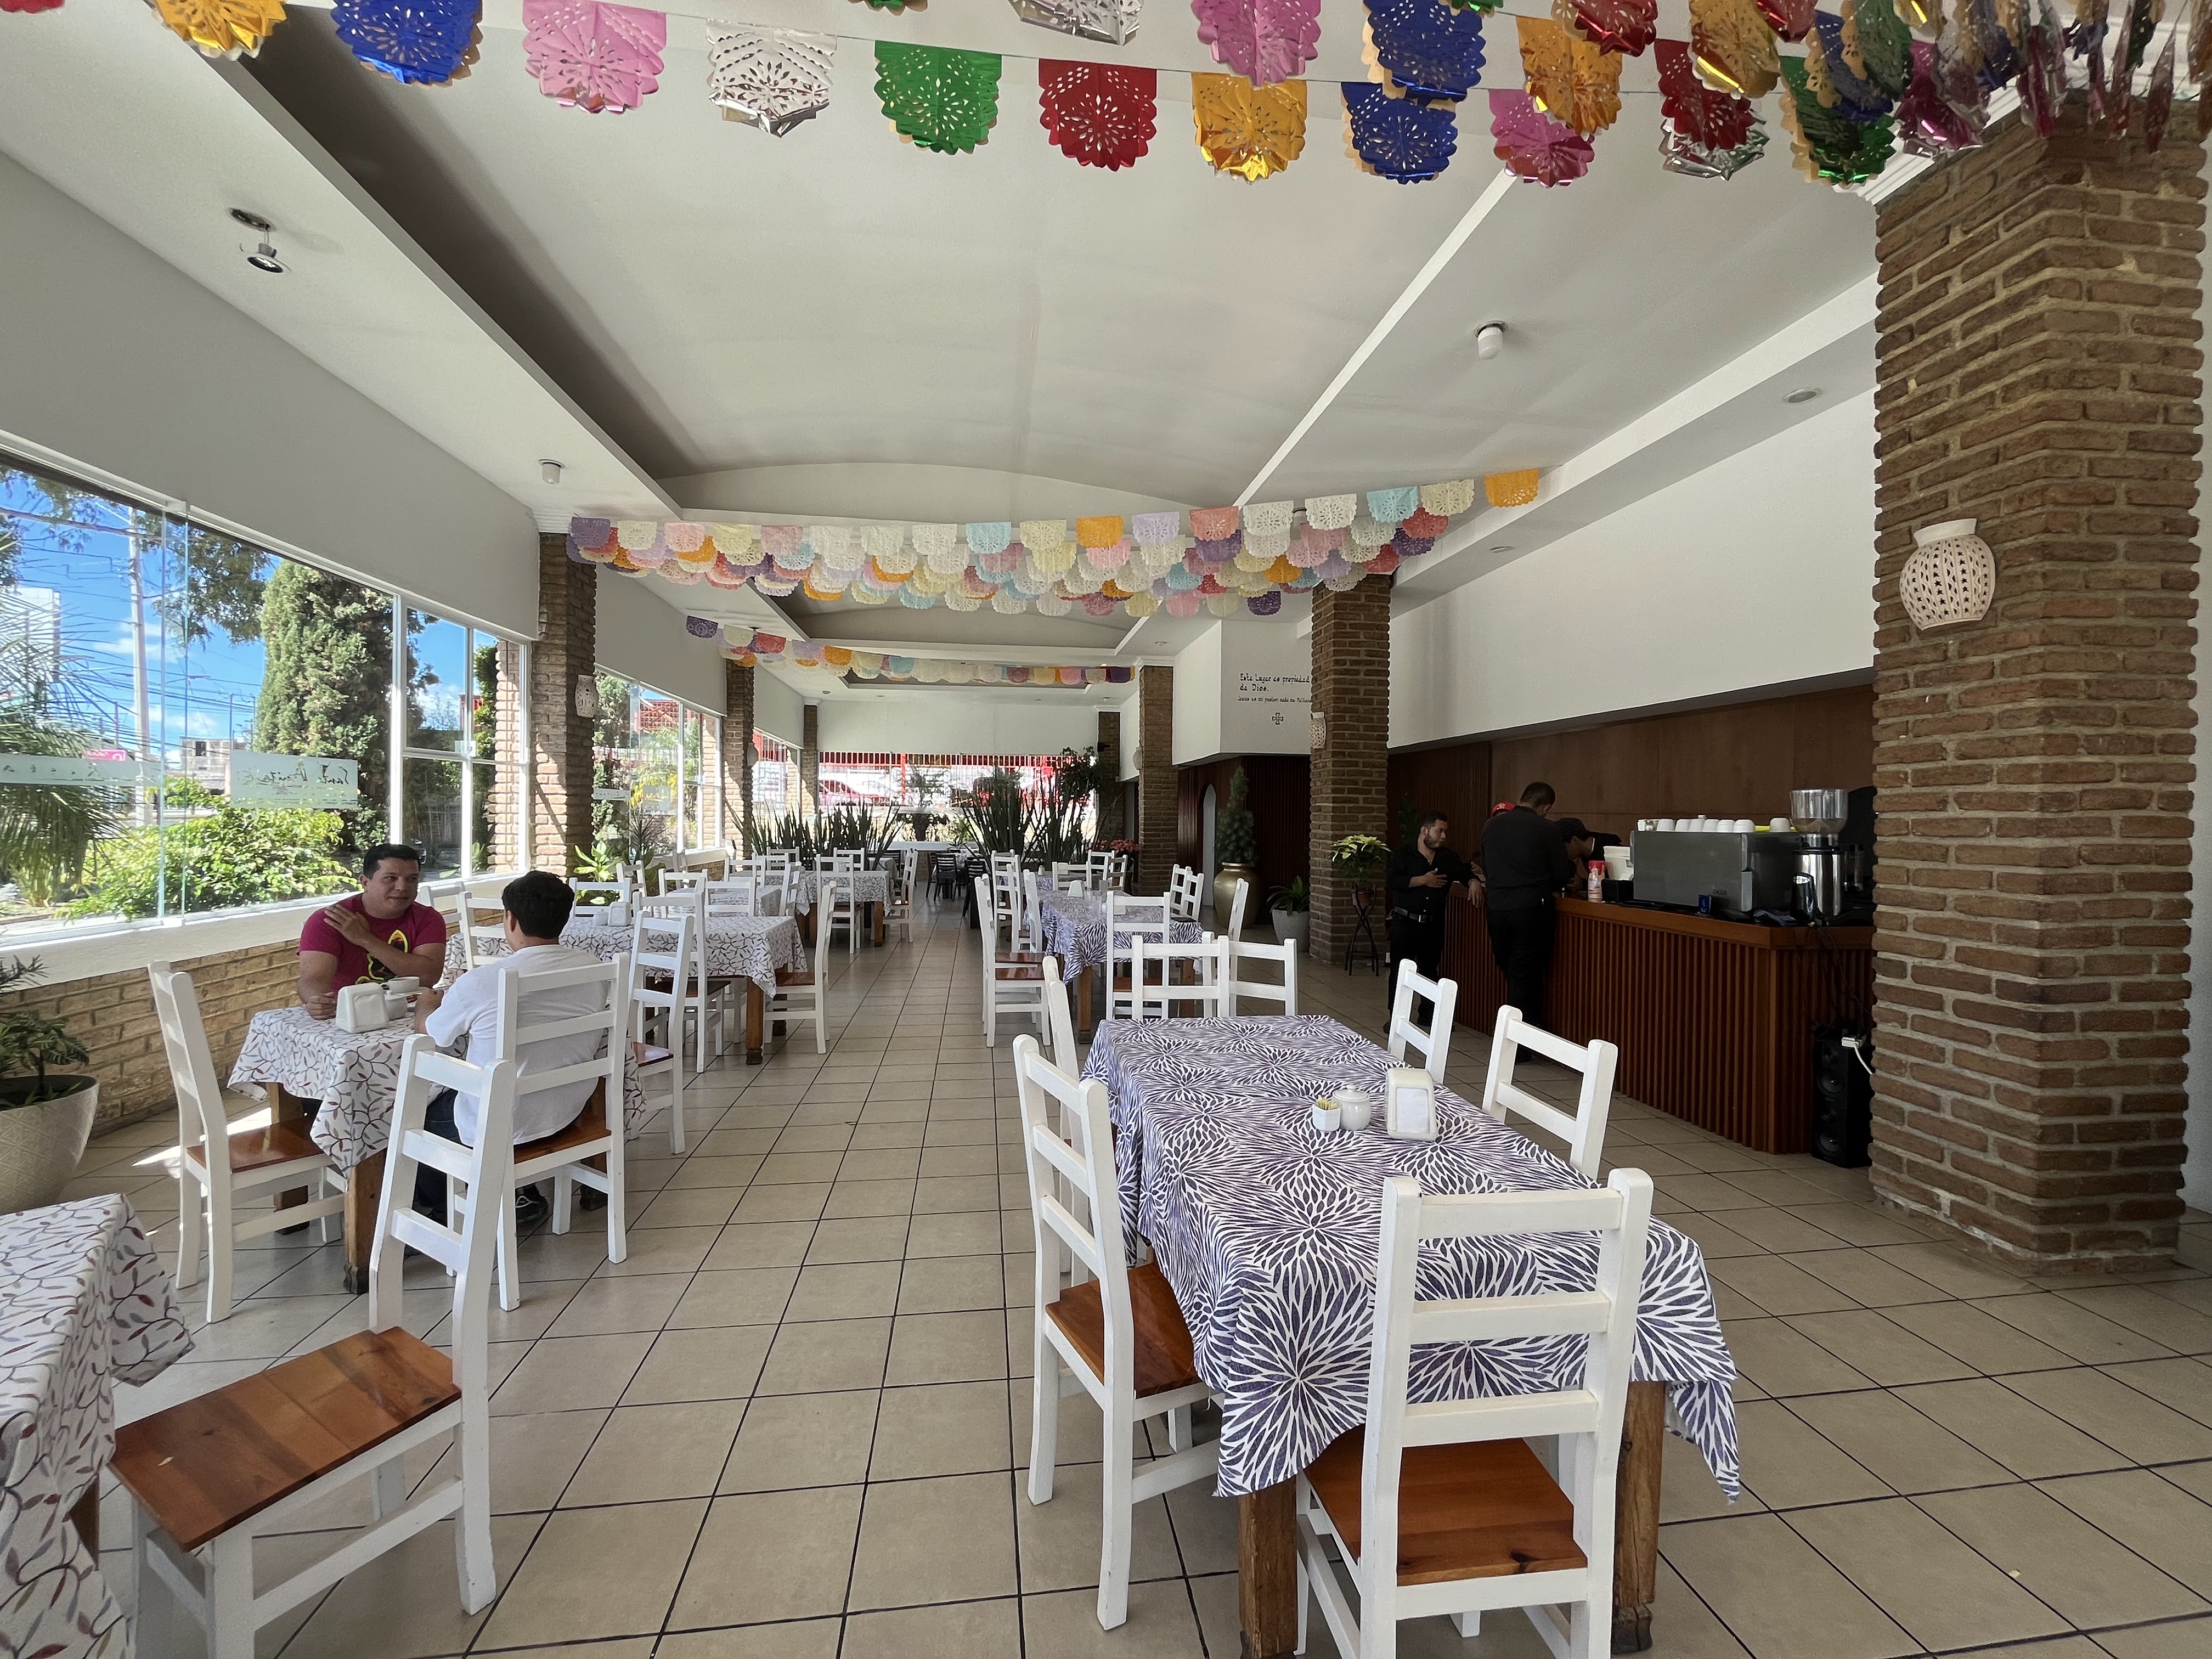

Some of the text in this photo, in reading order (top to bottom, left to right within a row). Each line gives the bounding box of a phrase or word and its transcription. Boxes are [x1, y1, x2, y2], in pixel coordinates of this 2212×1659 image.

[1240, 673, 1253, 681] Este
[1282, 675, 1310, 685] propiedad
[1239, 683, 1248, 691] de
